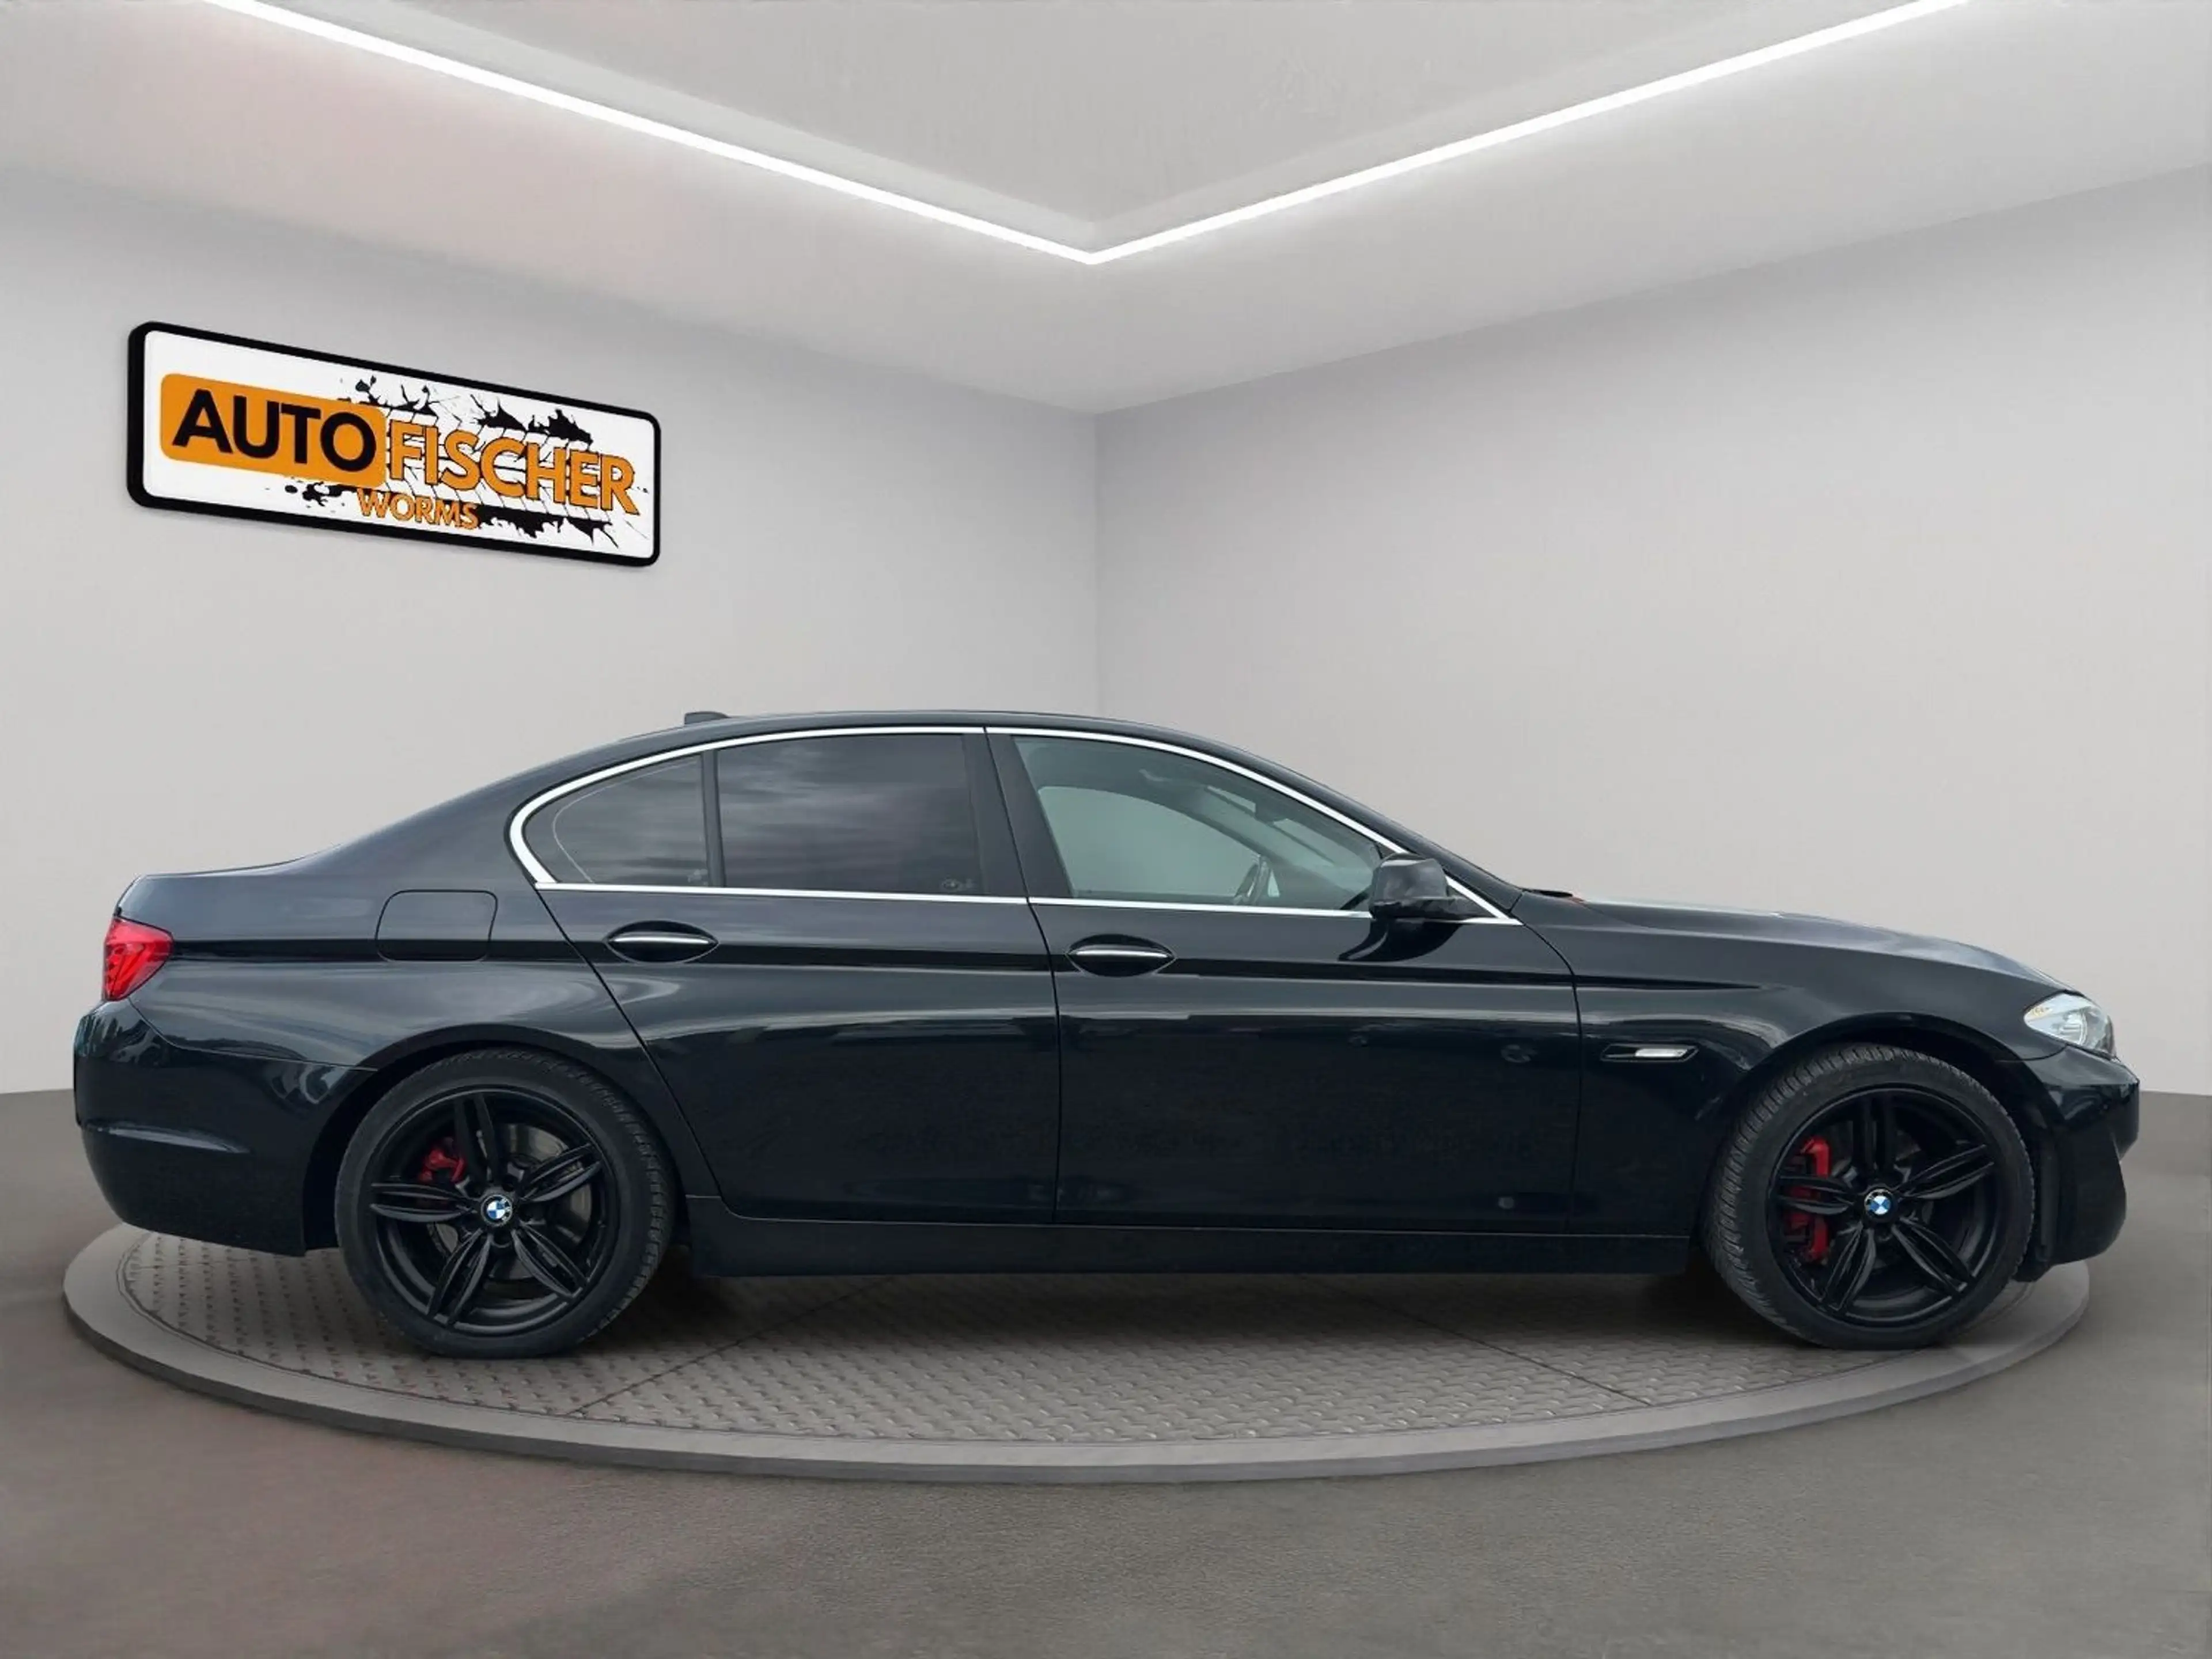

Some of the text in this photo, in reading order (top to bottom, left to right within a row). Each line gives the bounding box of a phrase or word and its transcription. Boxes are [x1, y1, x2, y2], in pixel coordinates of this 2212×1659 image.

[172, 389, 639, 514] AUTO FISCHER
[356, 487, 480, 530] WORMS
